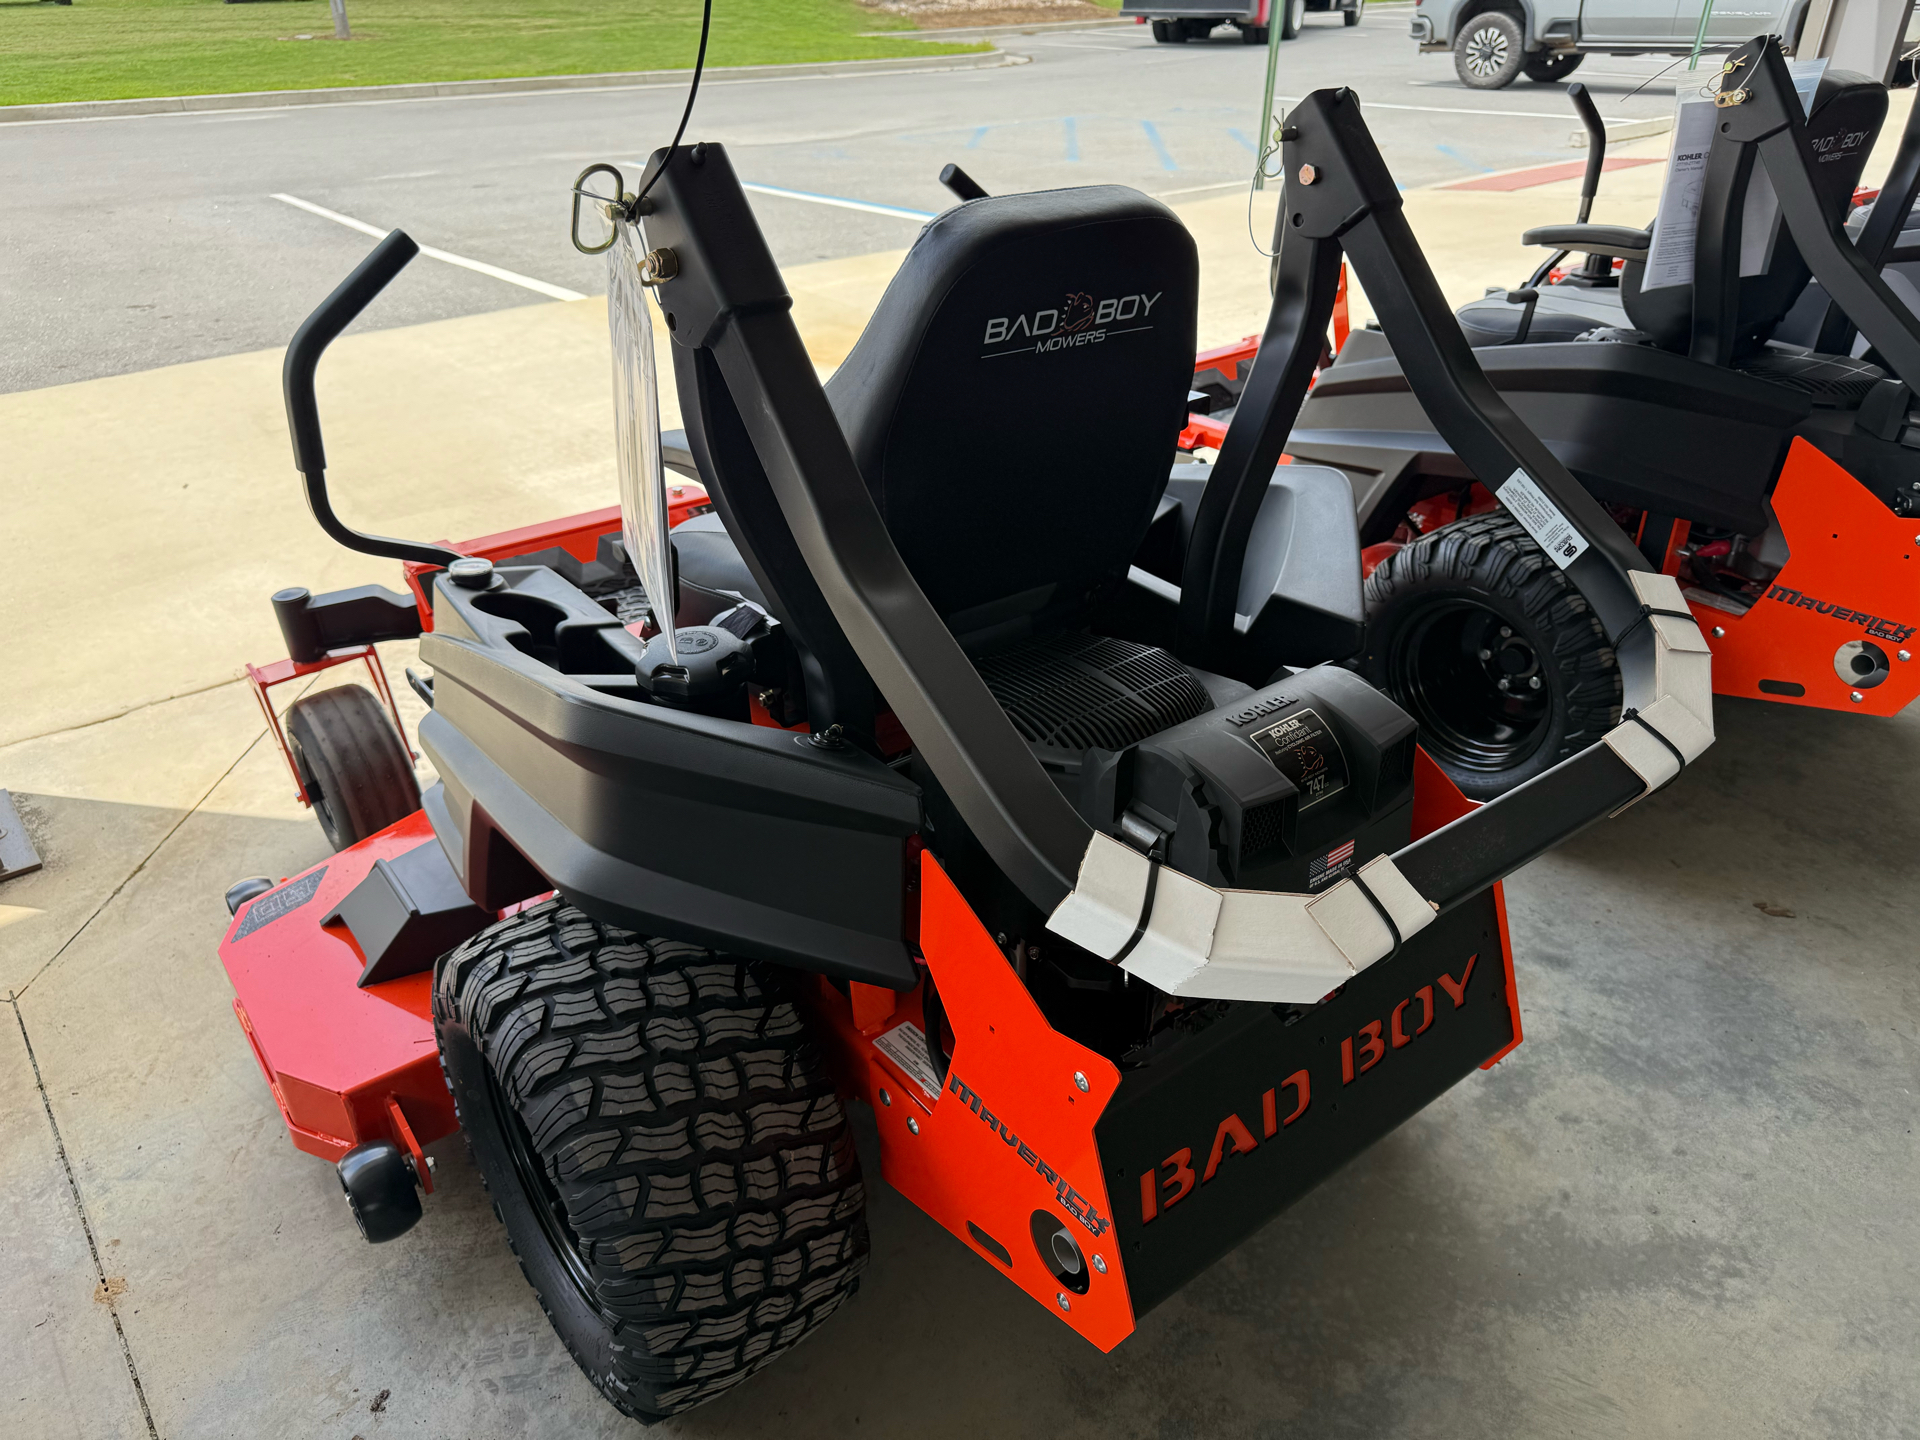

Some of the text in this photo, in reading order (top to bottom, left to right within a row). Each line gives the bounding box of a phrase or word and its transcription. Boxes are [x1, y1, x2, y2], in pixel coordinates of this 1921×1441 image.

[1841, 131, 1869, 149] BOY
[1677, 152, 1703, 162] KOHLER
[984, 292, 1162, 344] BAD BOY
[1036, 329, 1106, 353] MOWERS
[1767, 584, 1917, 638] MAVERICK
[1868, 629, 1901, 642] BAD BOY
[1226, 695, 1299, 727] KOHLER
[1268, 720, 1303, 738] KOHLER
[1274, 726, 1311, 747] Confidant
[1307, 775, 1325, 795] 747
[1140, 953, 1479, 1224] BAD BOY
[949, 1072, 1110, 1234] MAVERICK
[1060, 1197, 1097, 1234] BAD BOY
